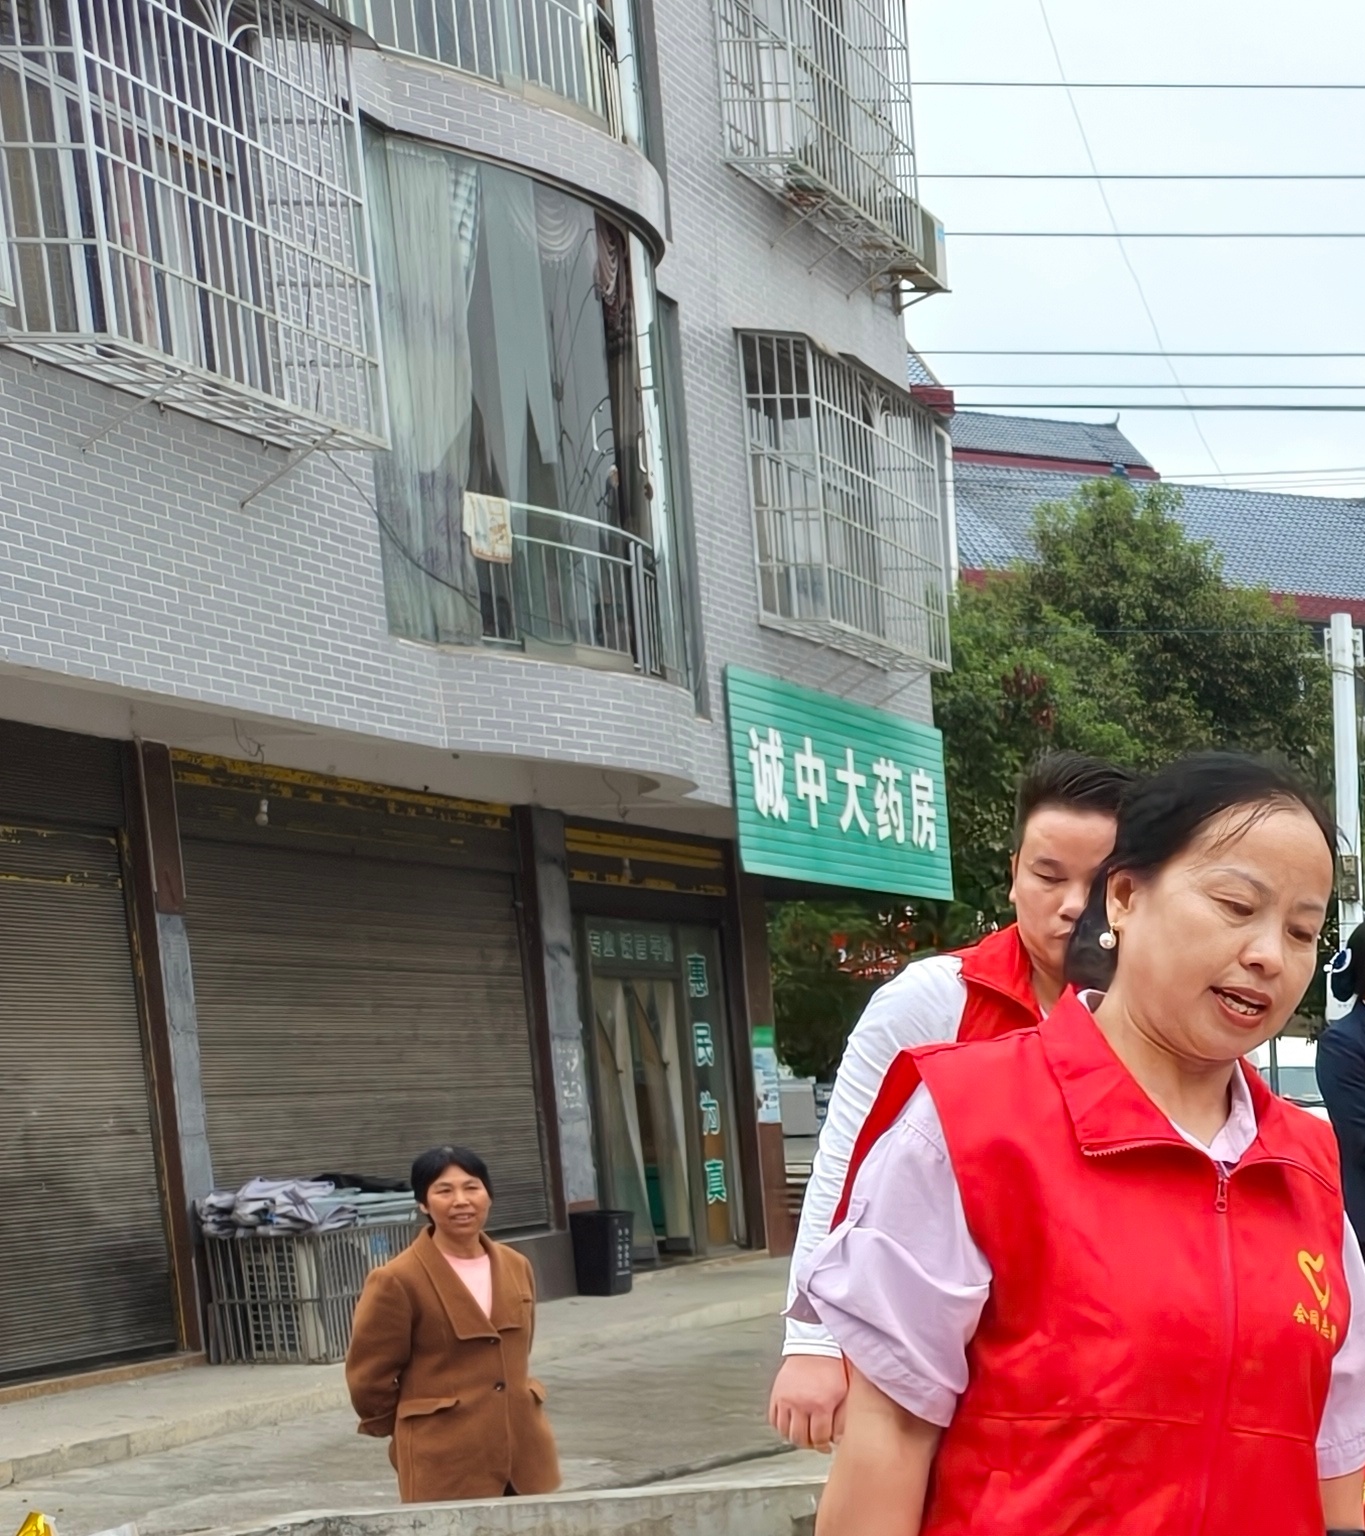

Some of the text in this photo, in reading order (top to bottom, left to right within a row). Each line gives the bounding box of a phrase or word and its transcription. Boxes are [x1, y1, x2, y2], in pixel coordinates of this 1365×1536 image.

[748, 727, 938, 851] 诚中大药房
